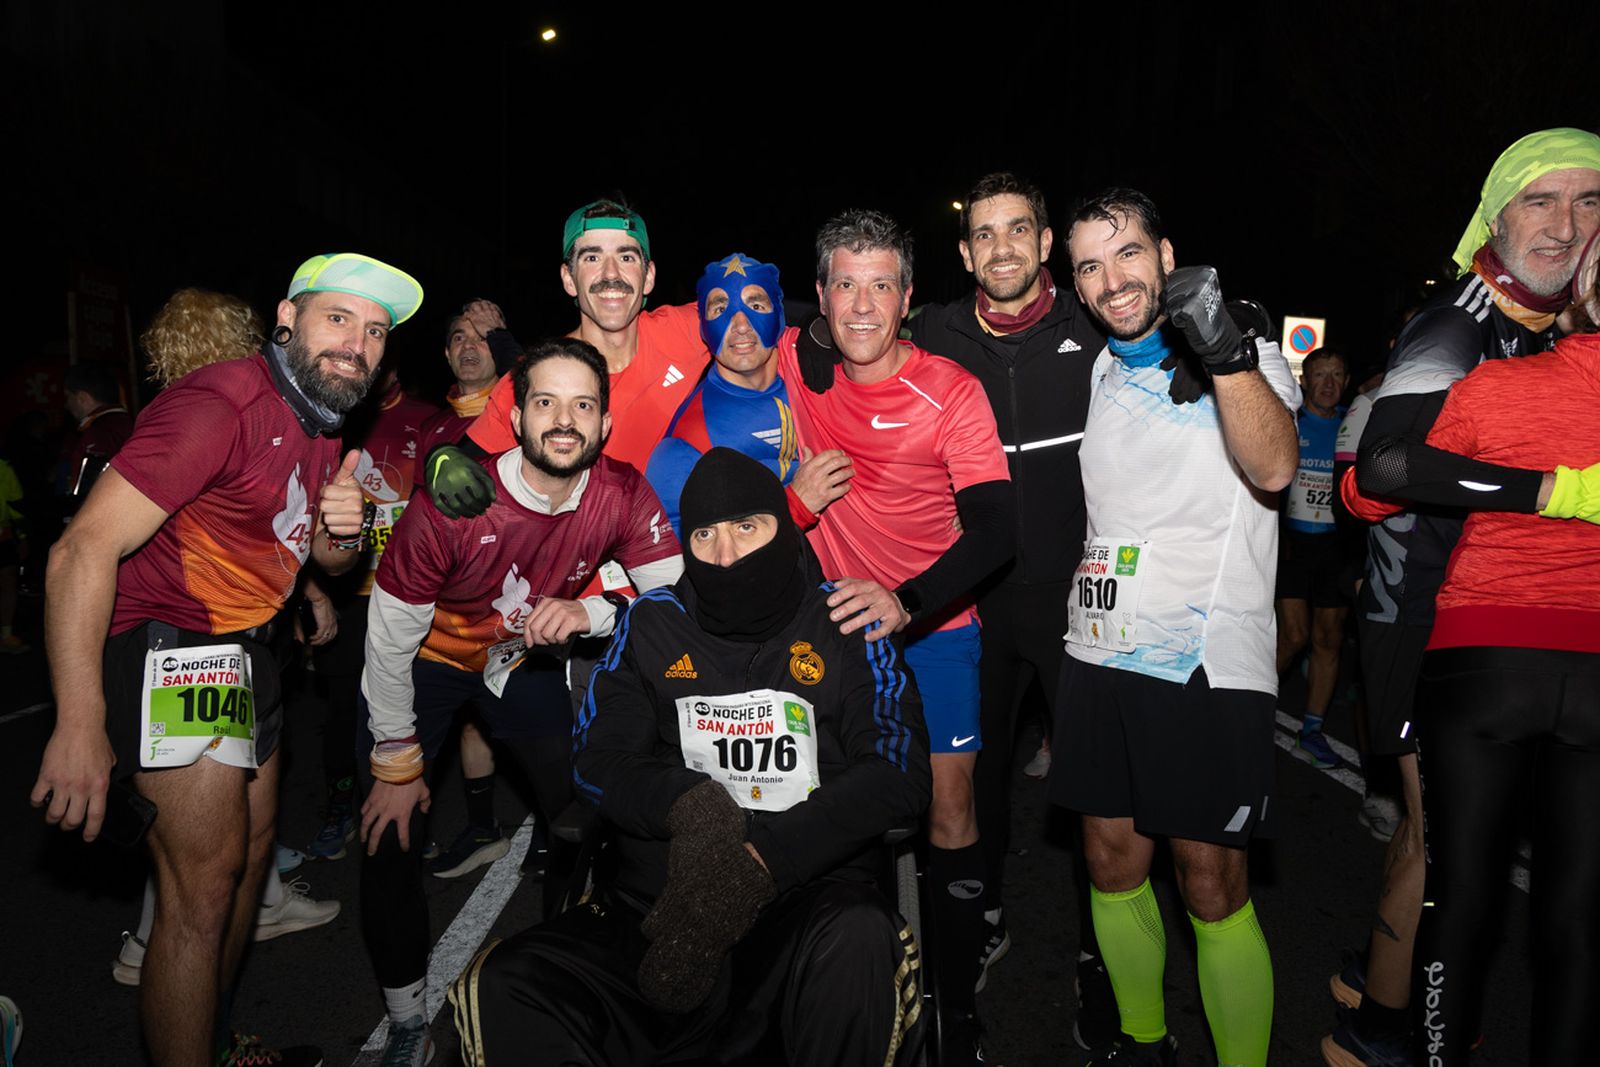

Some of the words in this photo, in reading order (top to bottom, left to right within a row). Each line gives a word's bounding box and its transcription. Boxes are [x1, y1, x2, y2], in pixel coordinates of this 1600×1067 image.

[1057, 345, 1082, 353] adidas
[362, 473, 382, 492] 43
[1097, 550, 1109, 560] DE
[1077, 576, 1118, 611] 1610
[181, 659, 226, 671] NOCHE
[162, 673, 194, 687] SAN
[196, 669, 241, 685] ANTÓN
[665, 670, 698, 679] adidas
[177, 687, 248, 725] 1046
[713, 707, 755, 721] NOCHE
[757, 704, 773, 719] DE
[697, 719, 725, 734] SAN
[726, 719, 774, 736] ANTÓN
[712, 734, 798, 772] 1076
[728, 773, 749, 782] Juan
[750, 775, 784, 784] Antonio
